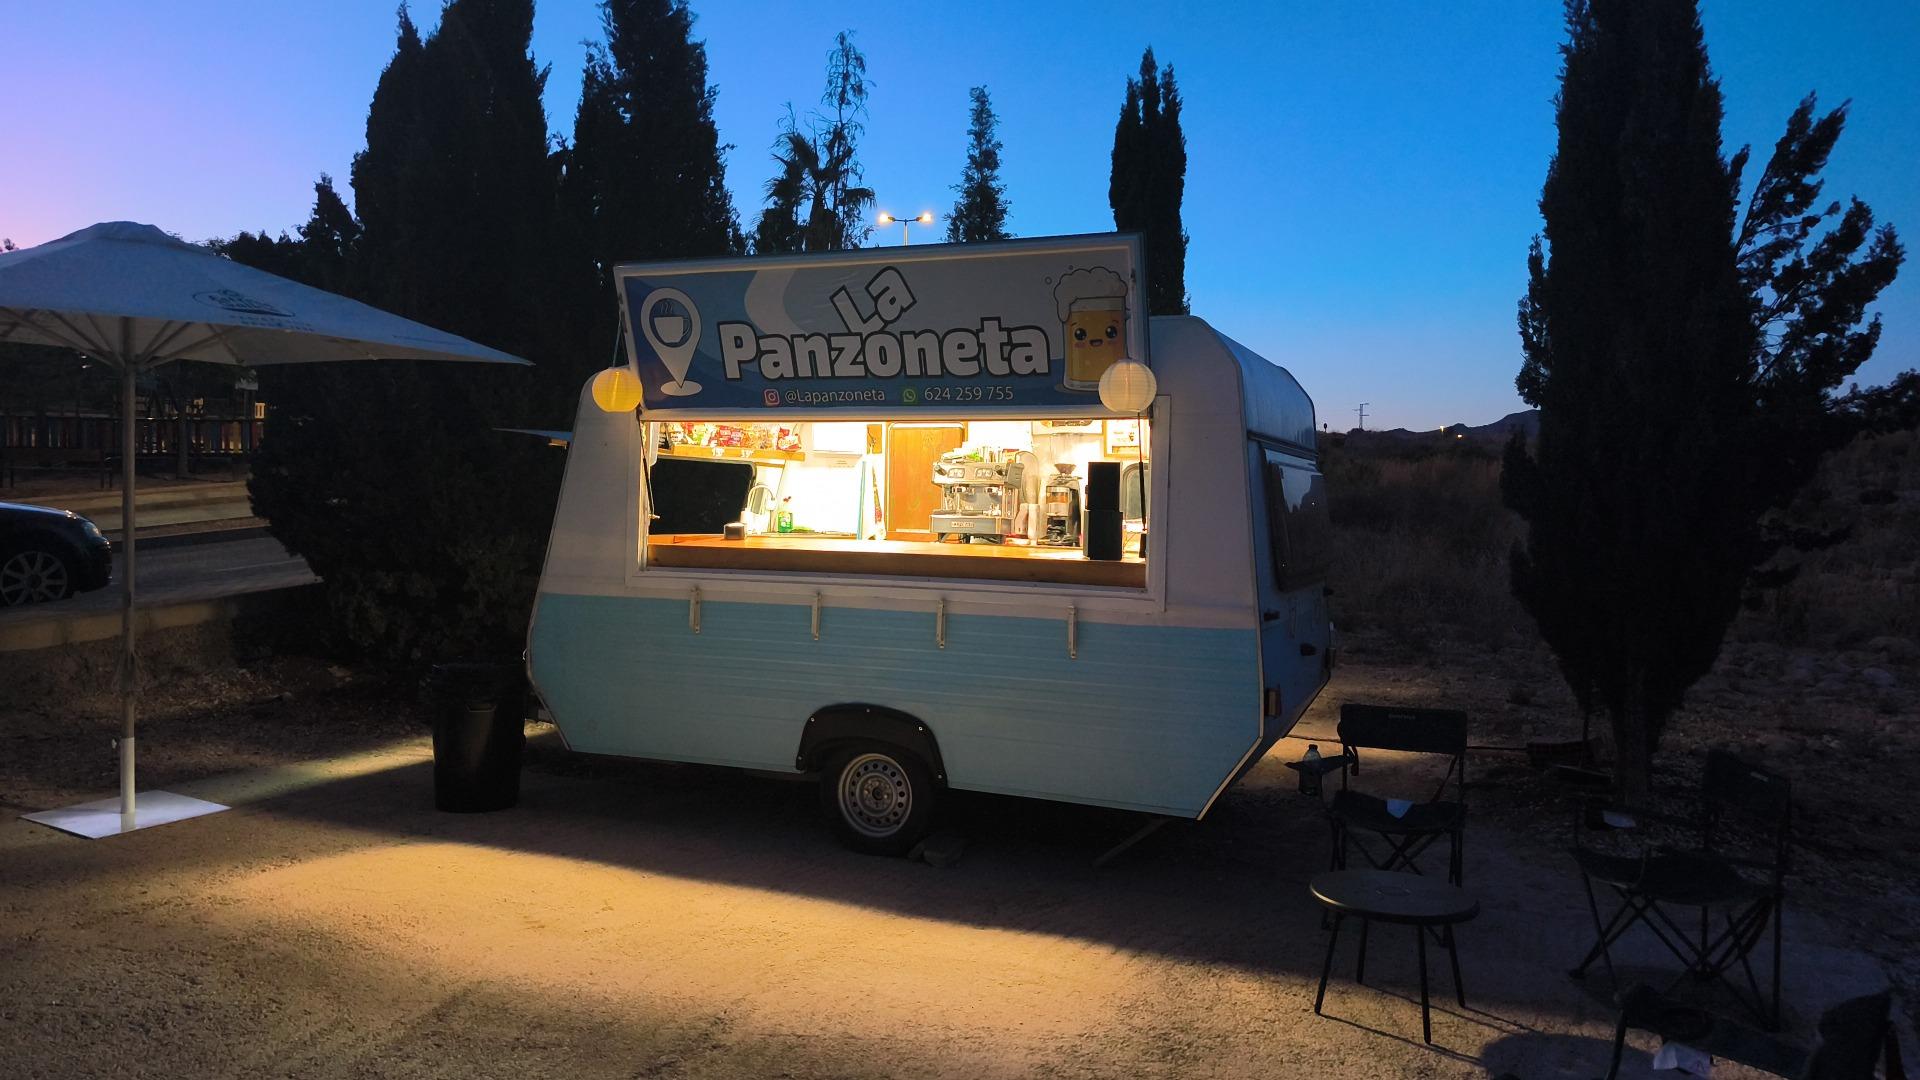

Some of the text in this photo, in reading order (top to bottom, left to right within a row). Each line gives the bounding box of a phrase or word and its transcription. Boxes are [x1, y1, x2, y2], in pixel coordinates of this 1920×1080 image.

[830, 266, 916, 335] La
[718, 316, 1051, 381] Panzoneta
[785, 388, 885, 404] @Lapanzoneta
[924, 386, 1014, 401] 624 259 755
